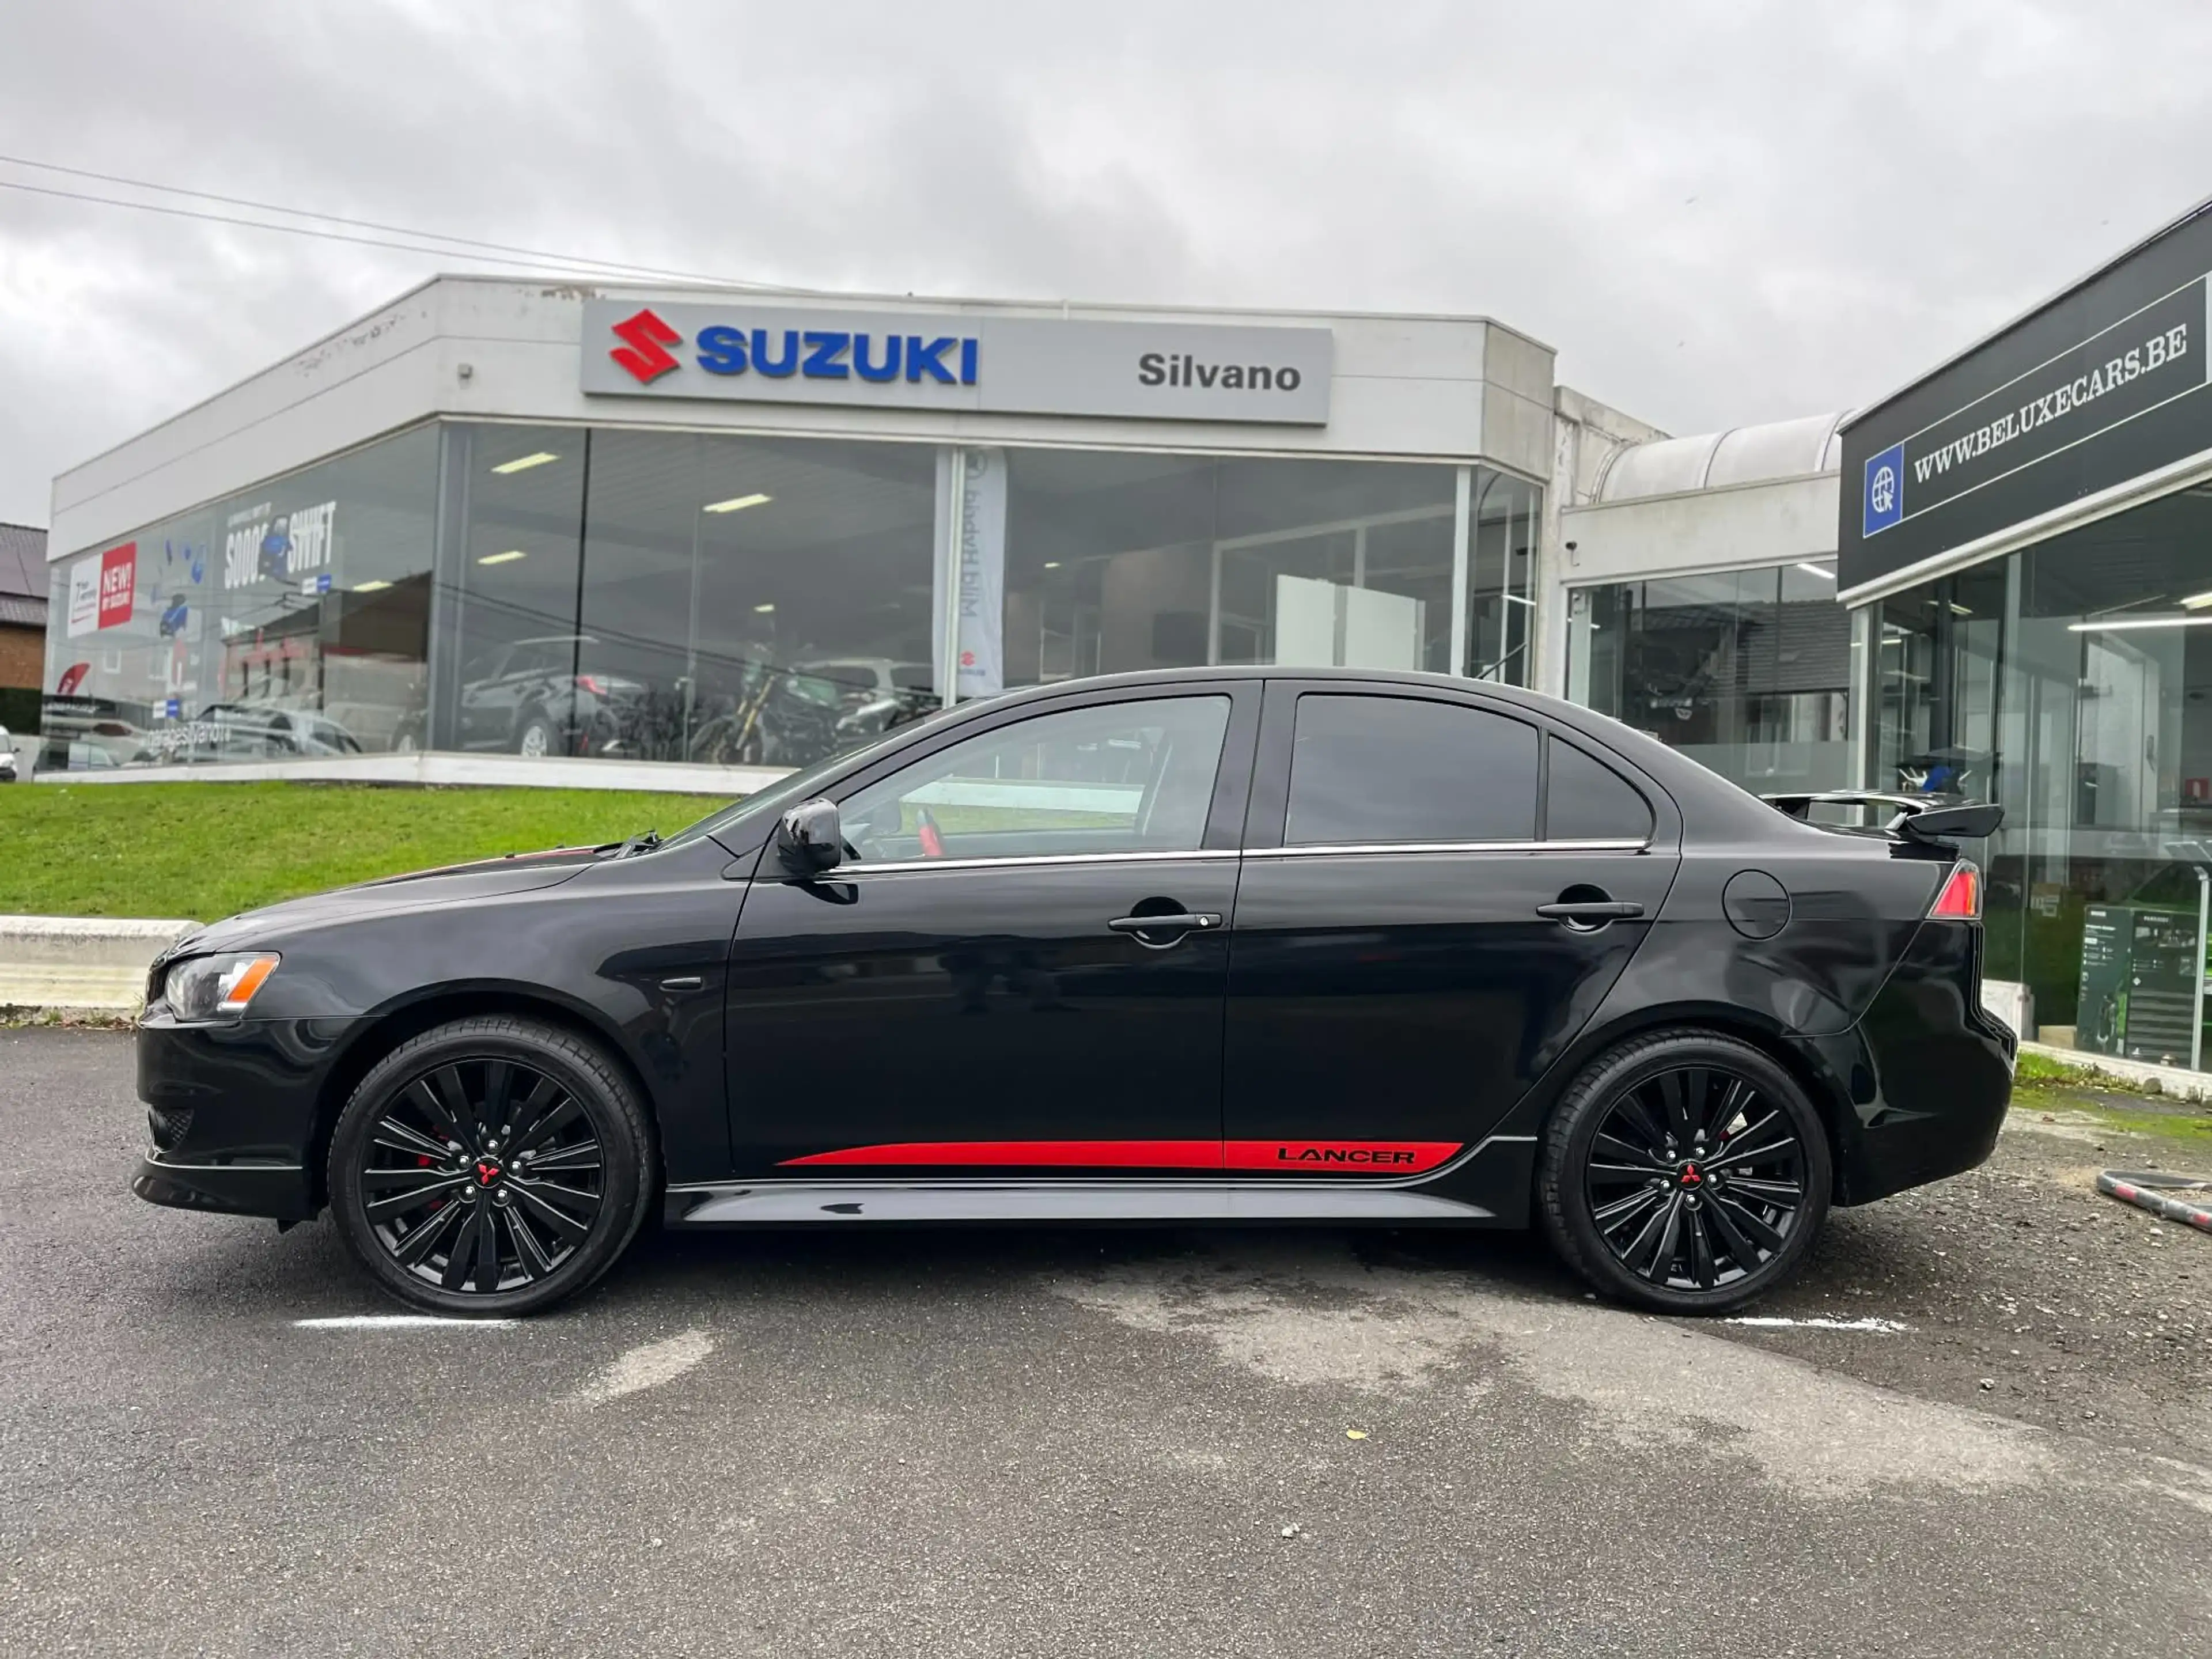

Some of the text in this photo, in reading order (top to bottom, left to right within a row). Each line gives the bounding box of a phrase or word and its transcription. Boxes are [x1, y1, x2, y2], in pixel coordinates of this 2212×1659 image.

[696, 325, 978, 385] SUZUKI
[1138, 353, 1301, 391] Silvano
[1914, 323, 2187, 483] WWW.BELUXECARS.BE
[287, 500, 337, 574] SWIFT
[103, 562, 132, 596] NEW!
[1277, 1147, 1415, 1164] LANCER
